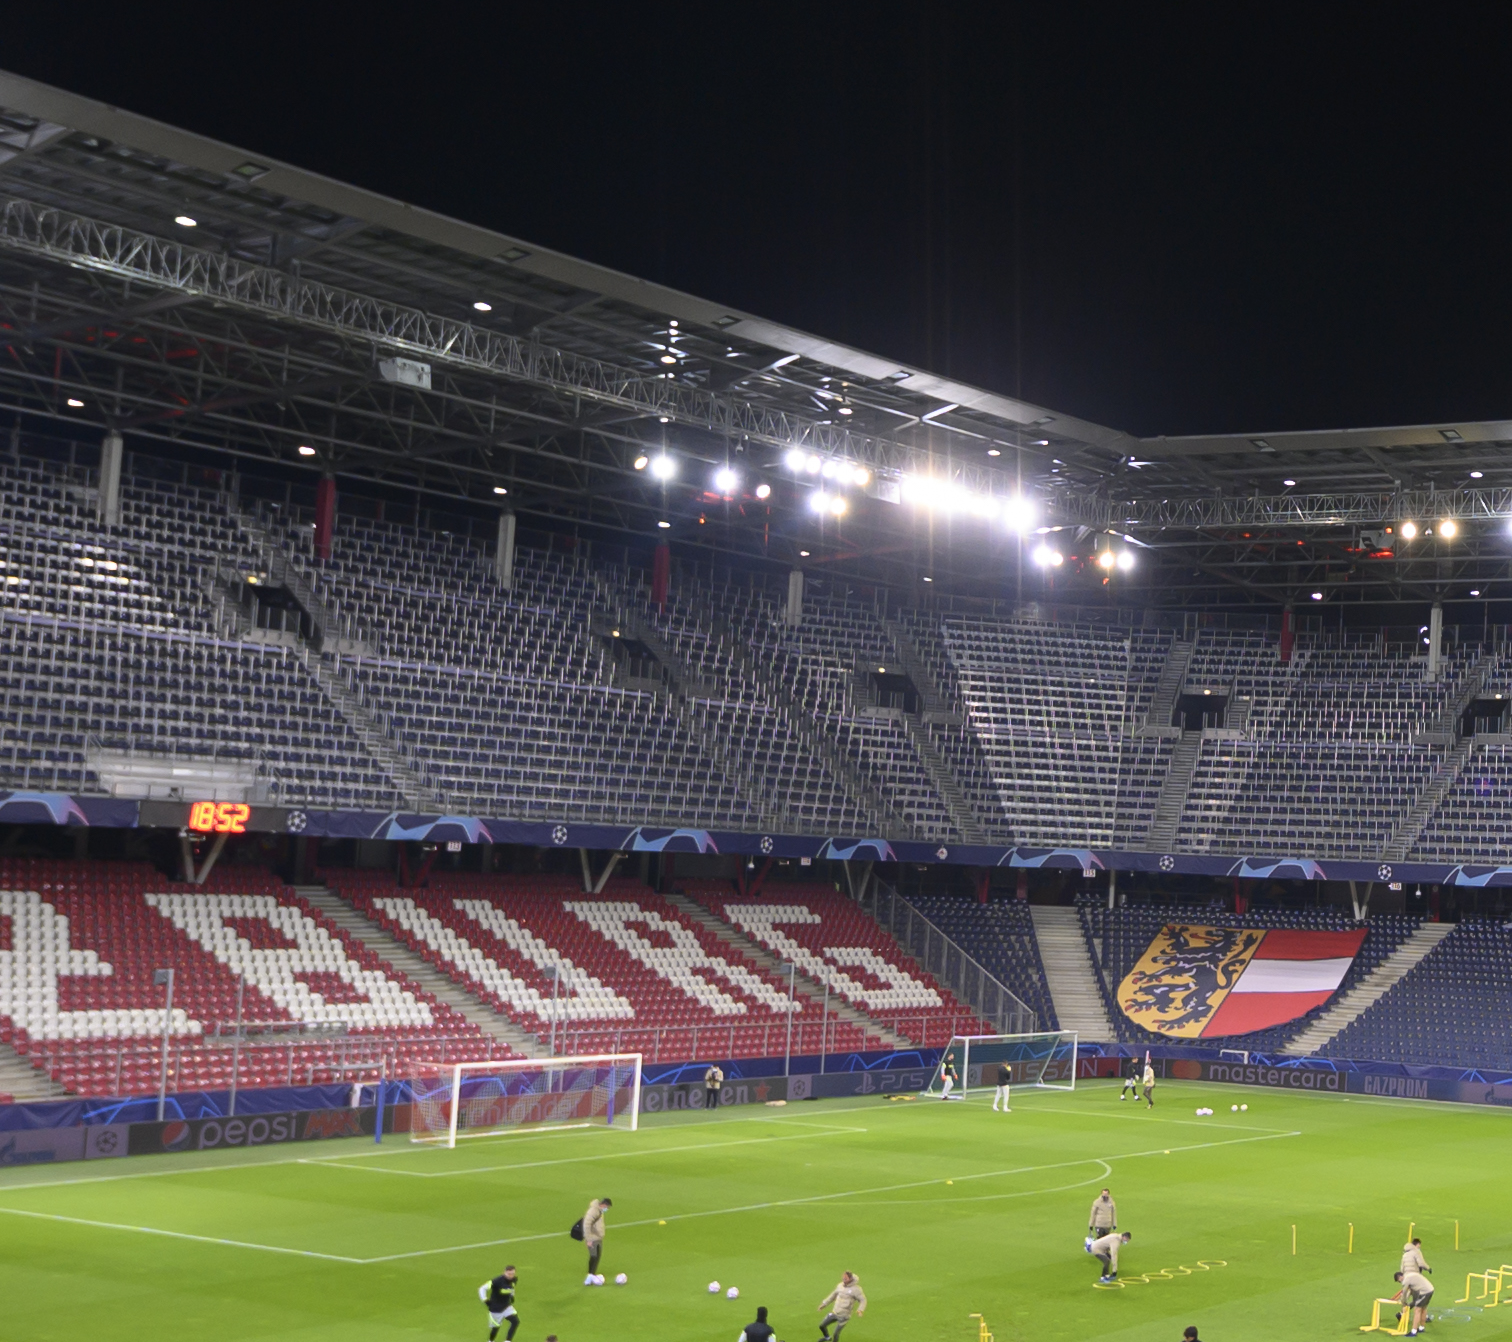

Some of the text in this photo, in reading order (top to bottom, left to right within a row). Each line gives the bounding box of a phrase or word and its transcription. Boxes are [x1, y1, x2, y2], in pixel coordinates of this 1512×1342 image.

[189, 802, 251, 833] 18:52
[881, 1070, 925, 1090] PS5
[1210, 1062, 1339, 1090] mastercard
[1363, 1075, 1429, 1098] GAZPROM
[631, 1083, 750, 1112] eineen
[198, 1108, 365, 1149] pepsi MAX
